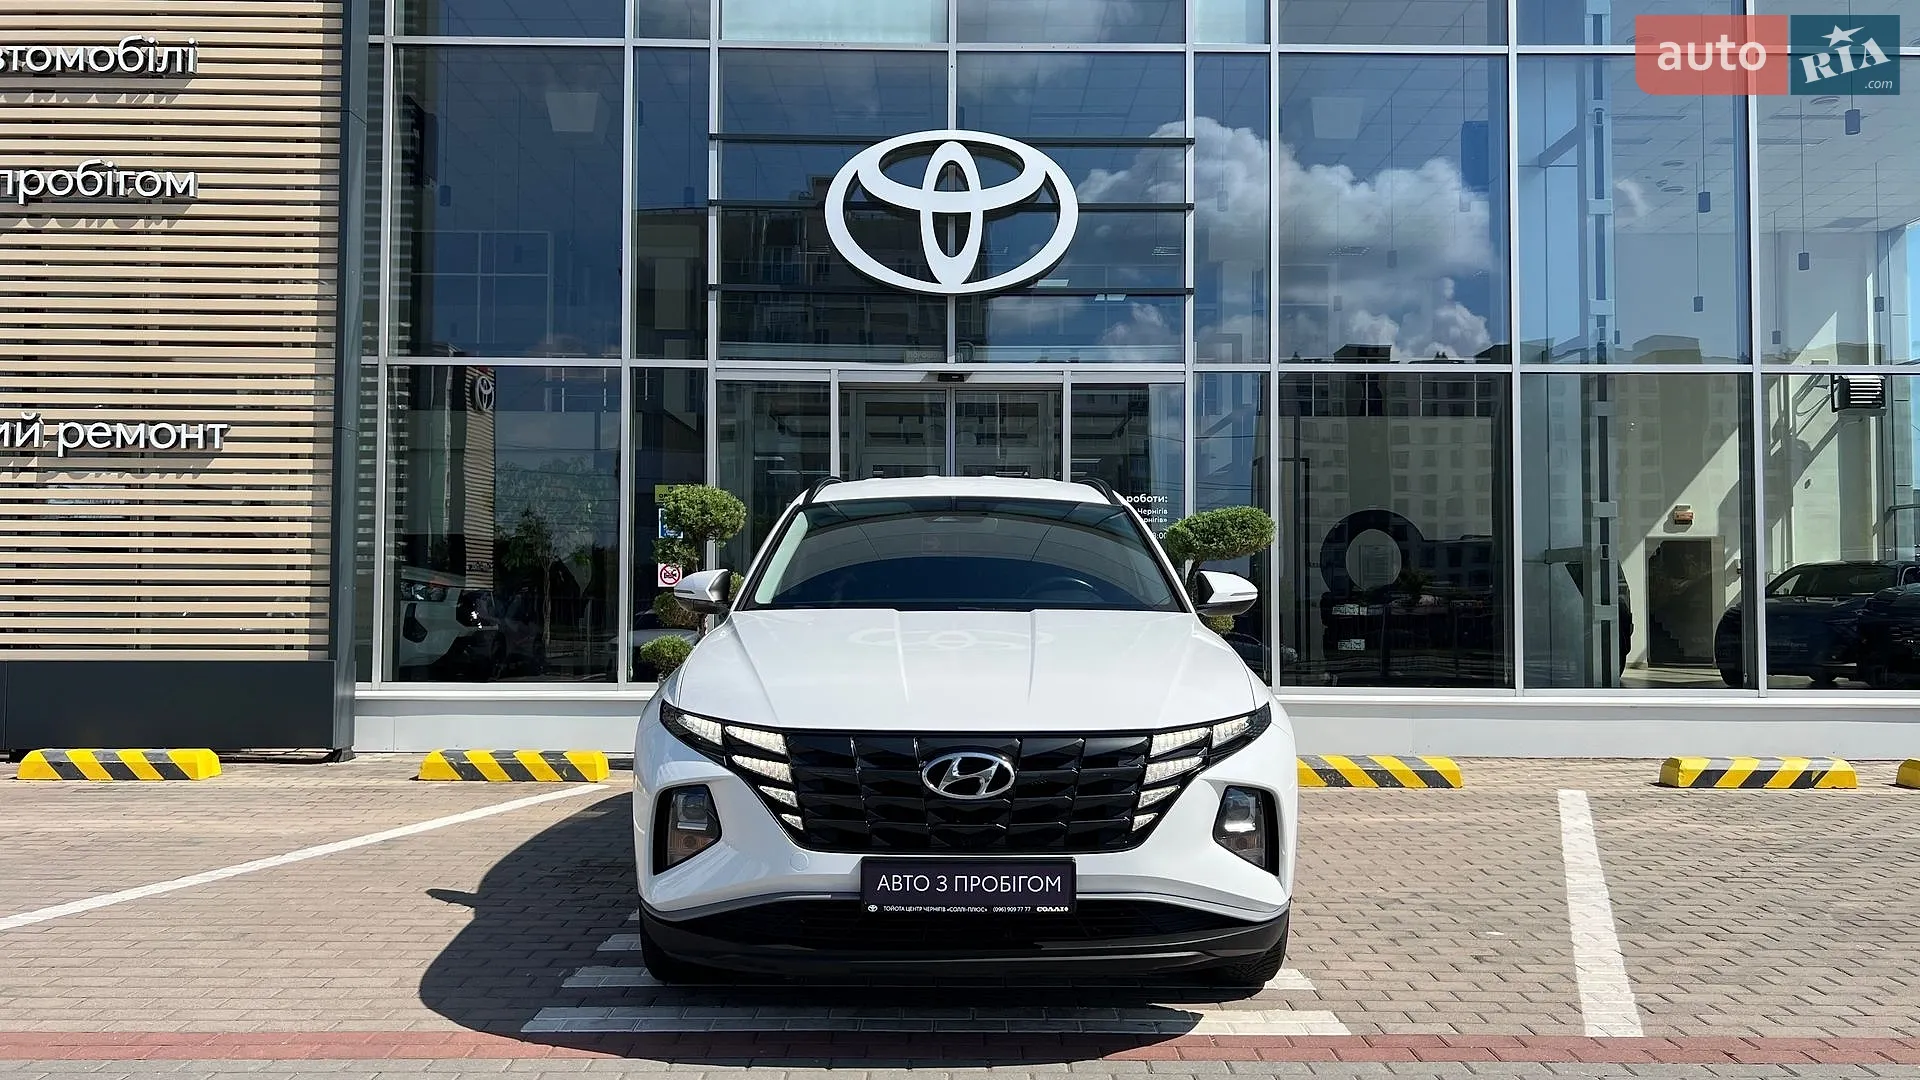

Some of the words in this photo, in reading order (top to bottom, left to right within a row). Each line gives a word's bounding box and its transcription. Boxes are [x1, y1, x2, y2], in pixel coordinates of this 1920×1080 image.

[0, 35, 196, 72] томобілі
[57, 421, 229, 457] ремонт
[877, 874, 930, 892] АВТО
[954, 875, 1062, 893] ПРОБІГОМ
